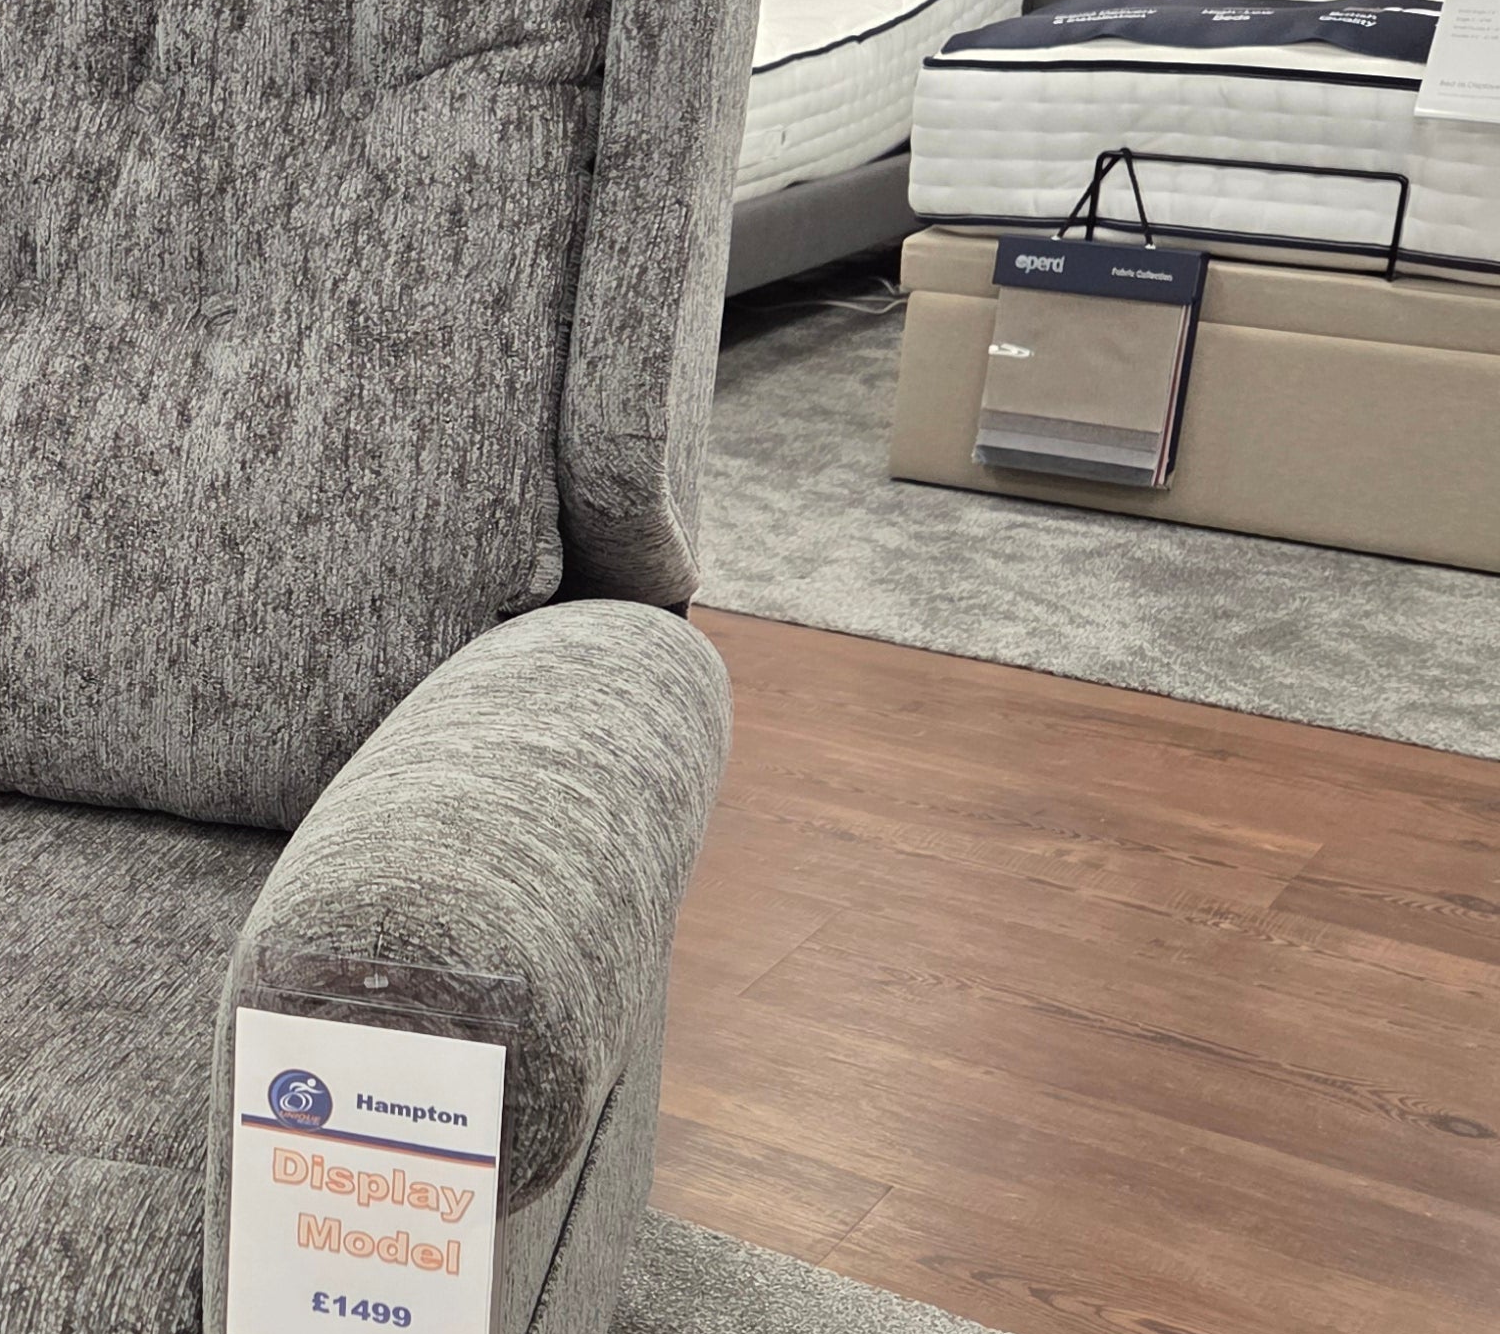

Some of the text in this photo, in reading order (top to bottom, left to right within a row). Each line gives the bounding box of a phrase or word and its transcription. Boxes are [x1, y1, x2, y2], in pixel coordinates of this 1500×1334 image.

[356, 1093, 469, 1127] Hampton
[272, 1146, 475, 1224] Display
[297, 1212, 461, 1276] Model
[311, 1291, 412, 1328] £1499
